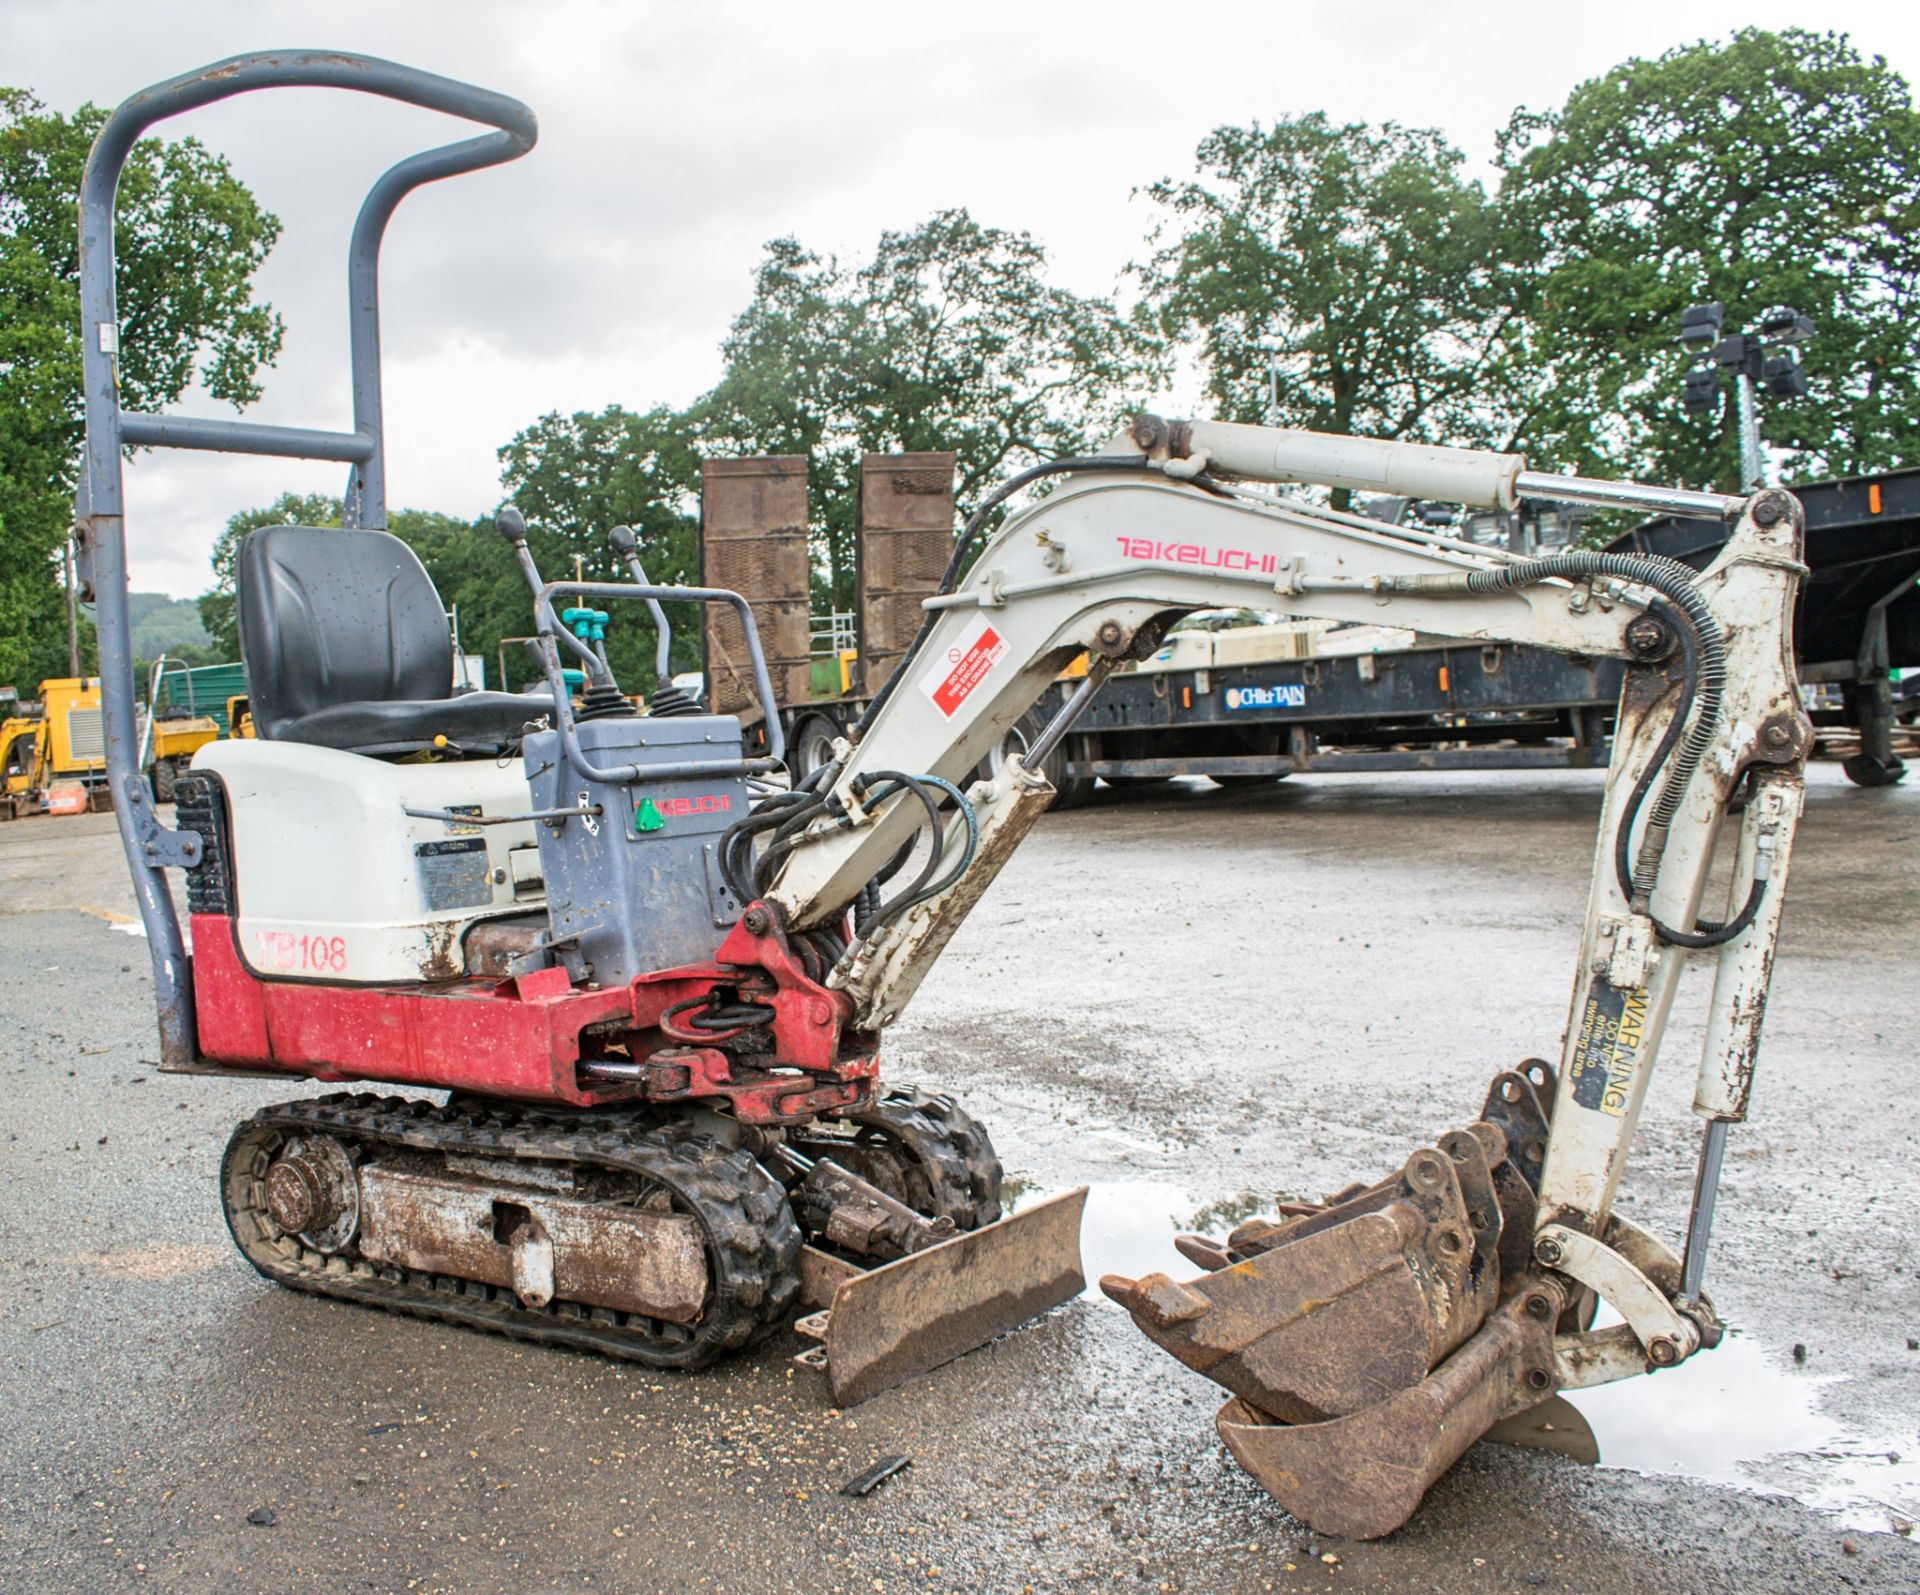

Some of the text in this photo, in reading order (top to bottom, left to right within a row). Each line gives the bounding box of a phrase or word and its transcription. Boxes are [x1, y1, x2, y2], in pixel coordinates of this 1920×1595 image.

[948, 648, 980, 685] DO NOT USE
[959, 686, 969, 697] AS
[970, 660, 991, 682] CRANE
[947, 683, 961, 697] THIS
[633, 794, 731, 817] KEUCHI
[255, 932, 347, 973] TB108
[1572, 1000, 1599, 1078] swinging area
[1593, 1014, 1607, 1046] enter
[1605, 1020, 1619, 1042] DO
[1604, 993, 1649, 1109] WARNING
